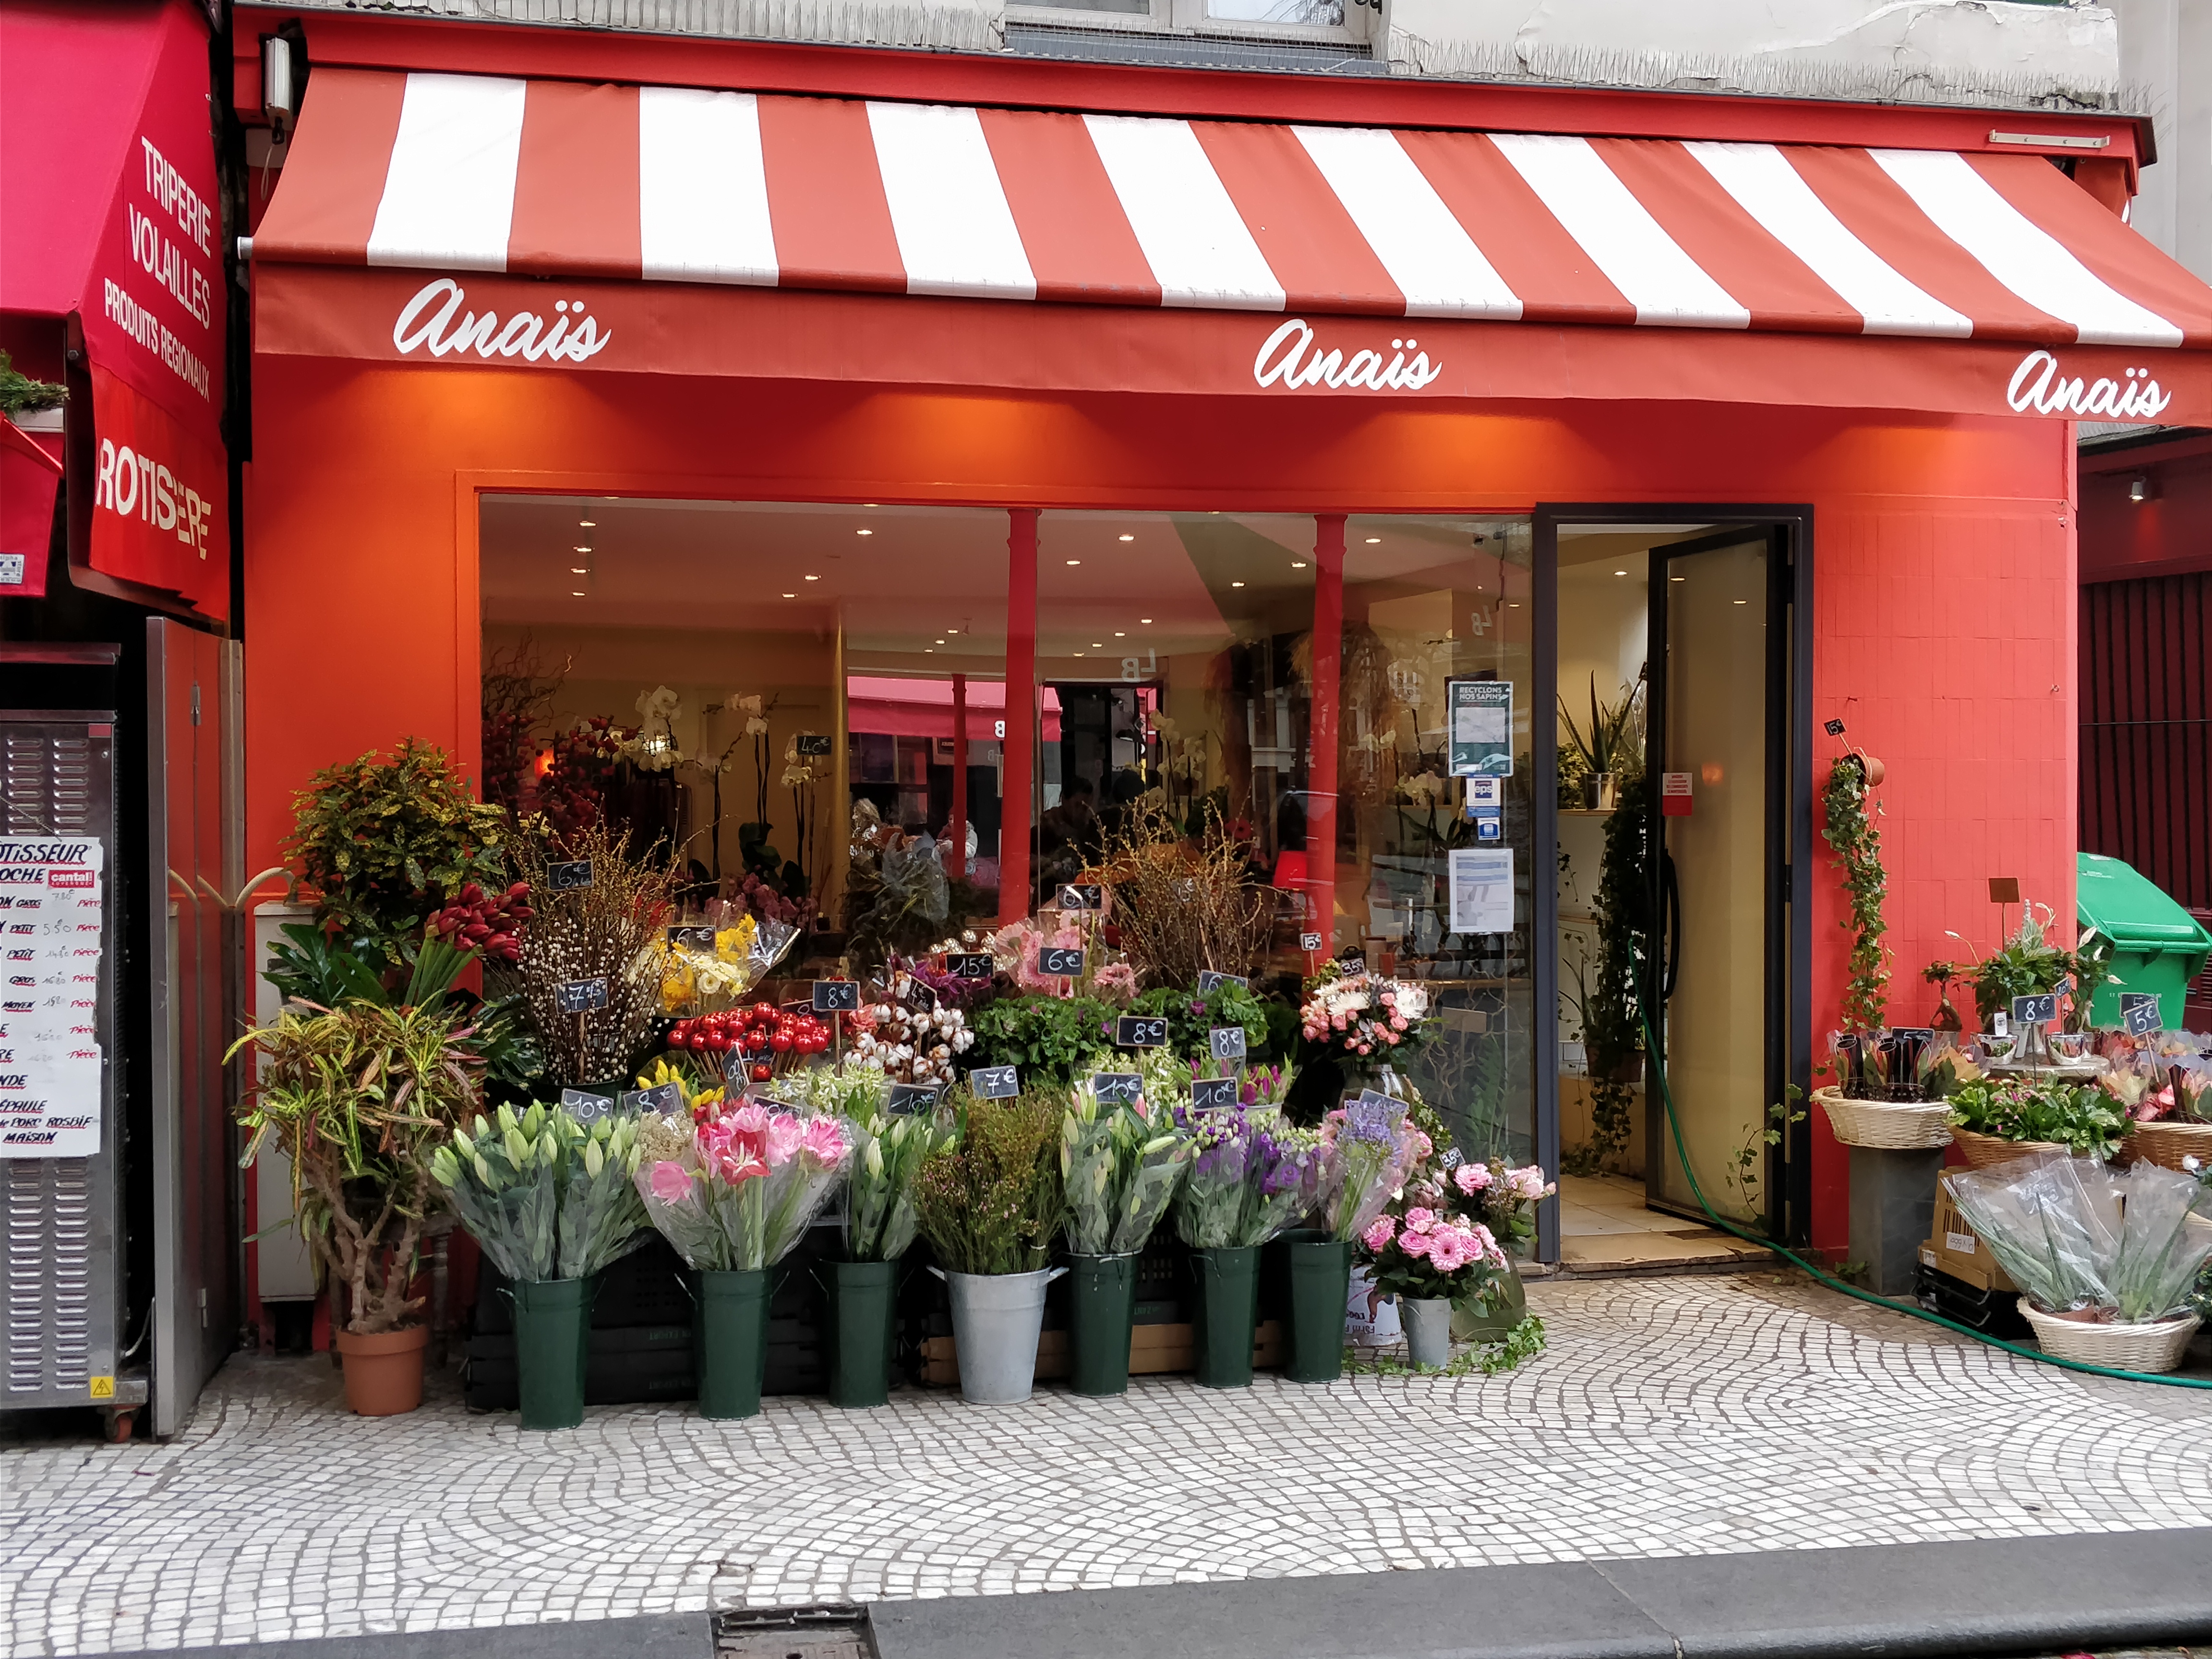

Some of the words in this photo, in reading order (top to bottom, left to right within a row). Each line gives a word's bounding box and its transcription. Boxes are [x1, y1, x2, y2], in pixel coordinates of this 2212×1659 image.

[142, 135, 211, 258] TRIPERIE
[129, 203, 209, 329] VOLAILLES
[105, 277, 158, 355] PRODUITS
[161, 324, 210, 402] REGIONAUX
[393, 278, 612, 361] Anaïs
[1254, 319, 1442, 390] Anaïs
[2007, 350, 2171, 418] Anaïs
